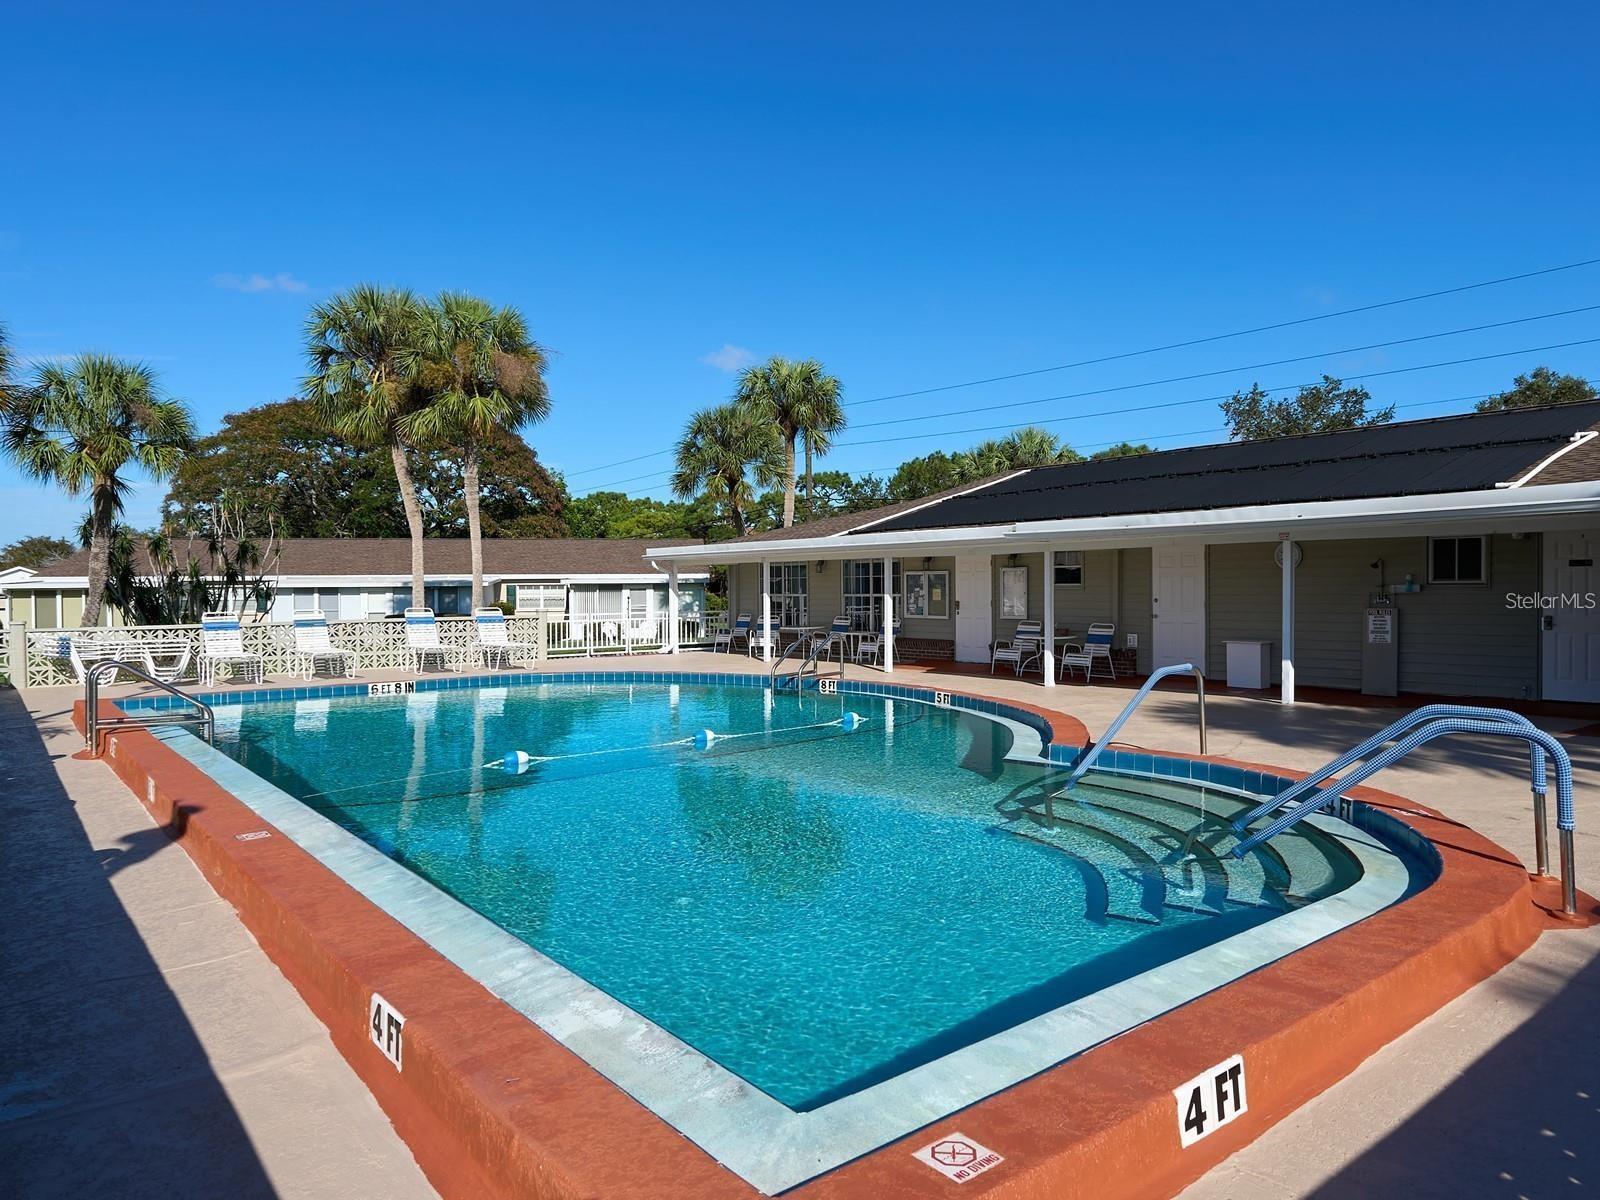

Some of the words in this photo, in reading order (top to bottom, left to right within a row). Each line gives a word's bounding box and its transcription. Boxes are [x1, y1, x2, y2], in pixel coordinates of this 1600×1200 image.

[394, 682, 402, 694] 8
[404, 681, 415, 694] IN
[821, 680, 827, 689] 8
[828, 680, 836, 690] FT
[936, 692, 942, 703] 5
[943, 693, 950, 704] FT
[1339, 796, 1352, 820] FT
[372, 1002, 382, 1043] 4
[386, 1012, 402, 1062] FT
[1184, 1085, 1207, 1135] 4
[1214, 1062, 1241, 1122] FT
[952, 1169, 971, 1180] NO
[966, 1153, 1000, 1173] DIVING
